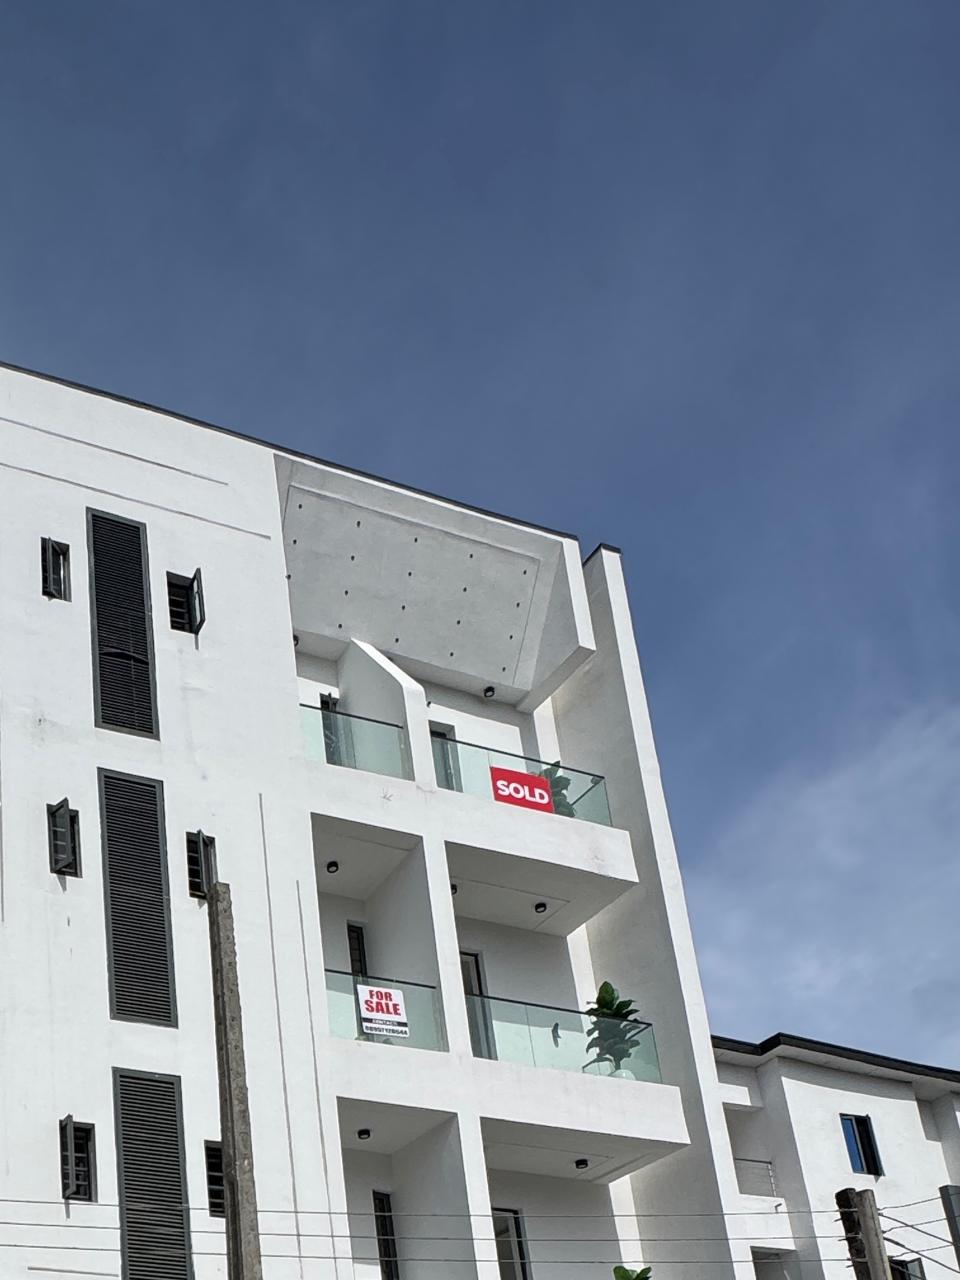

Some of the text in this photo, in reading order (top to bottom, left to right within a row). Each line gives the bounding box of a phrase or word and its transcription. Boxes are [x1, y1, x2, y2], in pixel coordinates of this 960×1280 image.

[496, 779, 549, 804] SOLD
[368, 989, 393, 1002] FOR
[364, 999, 402, 1017] SALE
